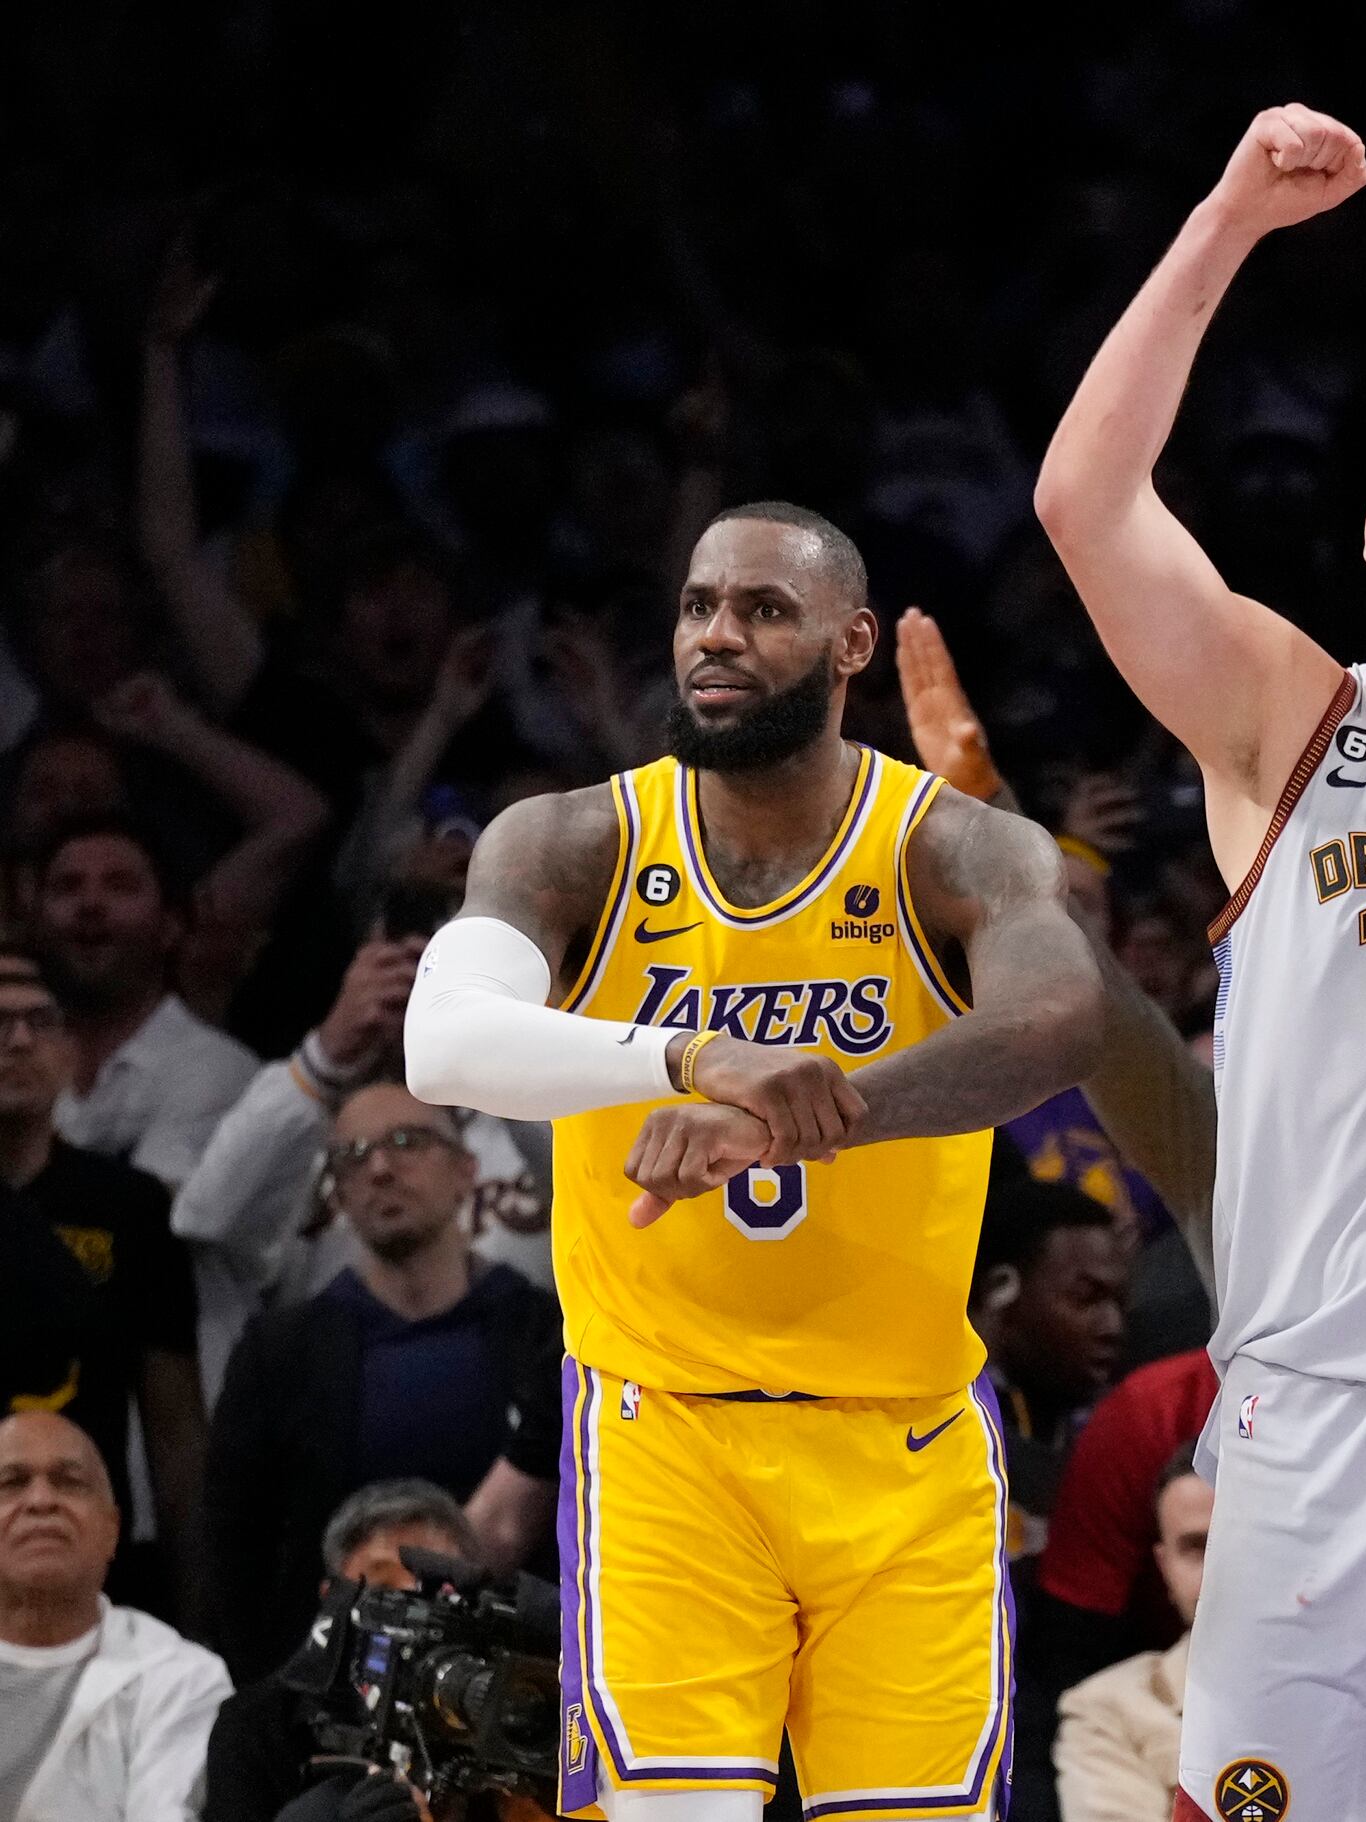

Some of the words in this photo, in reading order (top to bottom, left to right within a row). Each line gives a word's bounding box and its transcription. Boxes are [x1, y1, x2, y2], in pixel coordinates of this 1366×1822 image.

[645, 868, 673, 902] 6
[831, 921, 894, 944] bibigo
[633, 964, 895, 1056] LAKERS
